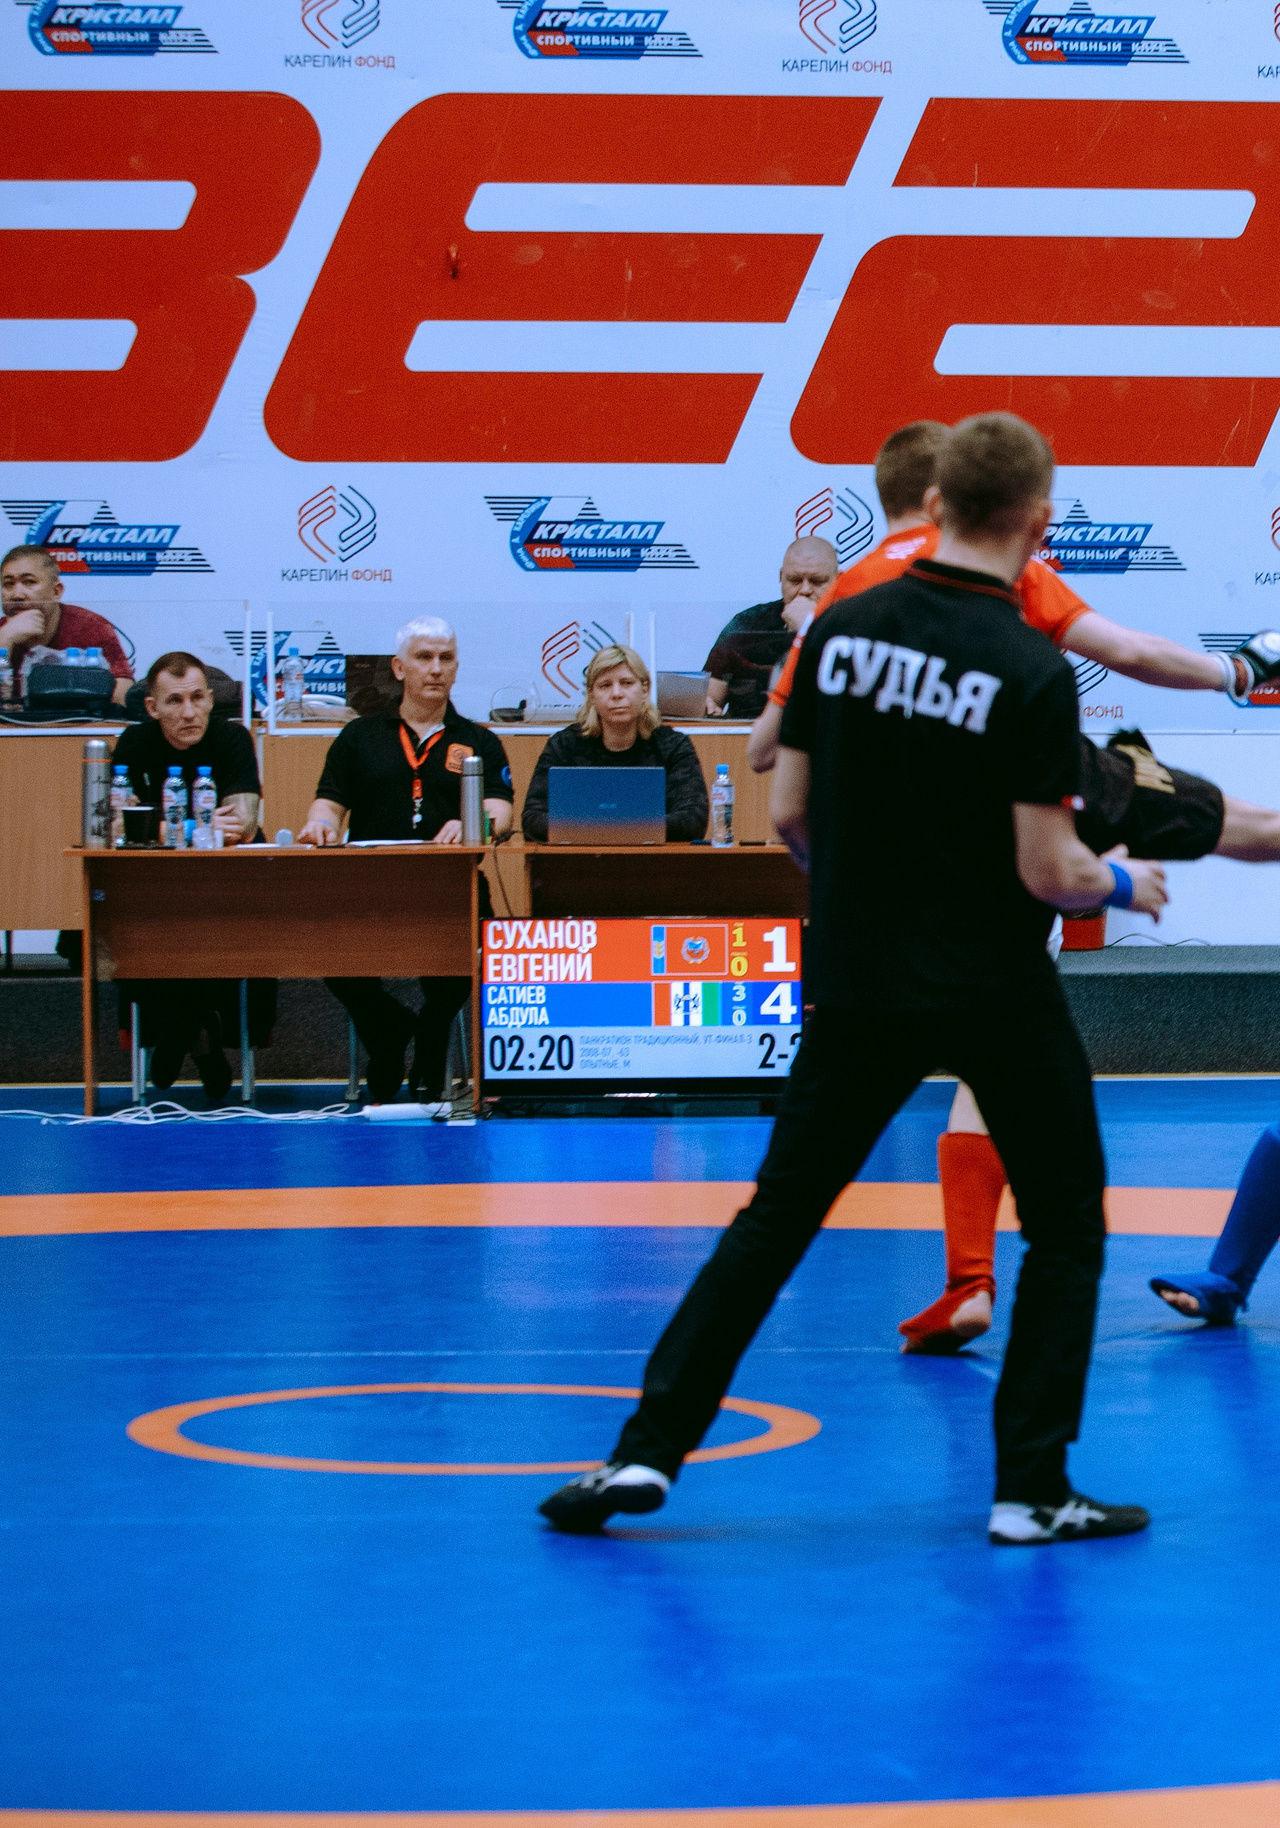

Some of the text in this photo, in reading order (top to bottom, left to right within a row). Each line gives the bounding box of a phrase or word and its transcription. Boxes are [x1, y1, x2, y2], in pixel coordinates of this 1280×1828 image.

[50, 6, 175, 24] КРИСТАЛЛ
[537, 11, 660, 28] КРИСТАЛЛ
[1024, 17, 1148, 34] КРИСТАЛЛ
[51, 31, 149, 42] СПОРТИВНЫЙ
[536, 35, 634, 46] СПОРТИВНЫЙ
[1024, 41, 1122, 52] СПОРТИВНЫЙ
[284, 55, 396, 69] КАРЕЛИН ФОНД
[782, 60, 893, 74] КАРЕЛИН ФОНД
[47, 527, 171, 543] КРИСТАЛЛ
[532, 523, 659, 540] КРИСТАЛЛ
[1042, 526, 1147, 542] РИСТАЛЛ
[533, 547, 631, 559] СПОРТИВНЫЙ
[280, 568, 393, 583] КАРЕЛИН ФОНД
[816, 635, 1001, 735] СУДЬЯ
[1083, 705, 1124, 719] ФОНД
[487, 920, 597, 950] СУХАНОВ
[731, 926, 747, 947] 1
[762, 926, 797, 972] 1
[487, 948, 593, 982] ЕВГЕНИЙ
[730, 956, 748, 977] 0
[487, 985, 547, 1005] САТИЕВ
[731, 985, 747, 1001] 3
[760, 982, 798, 1024] 4
[487, 1006, 550, 1027] АБДУЛА
[731, 1009, 747, 1026] 0
[489, 1034, 574, 1071] 02:20
